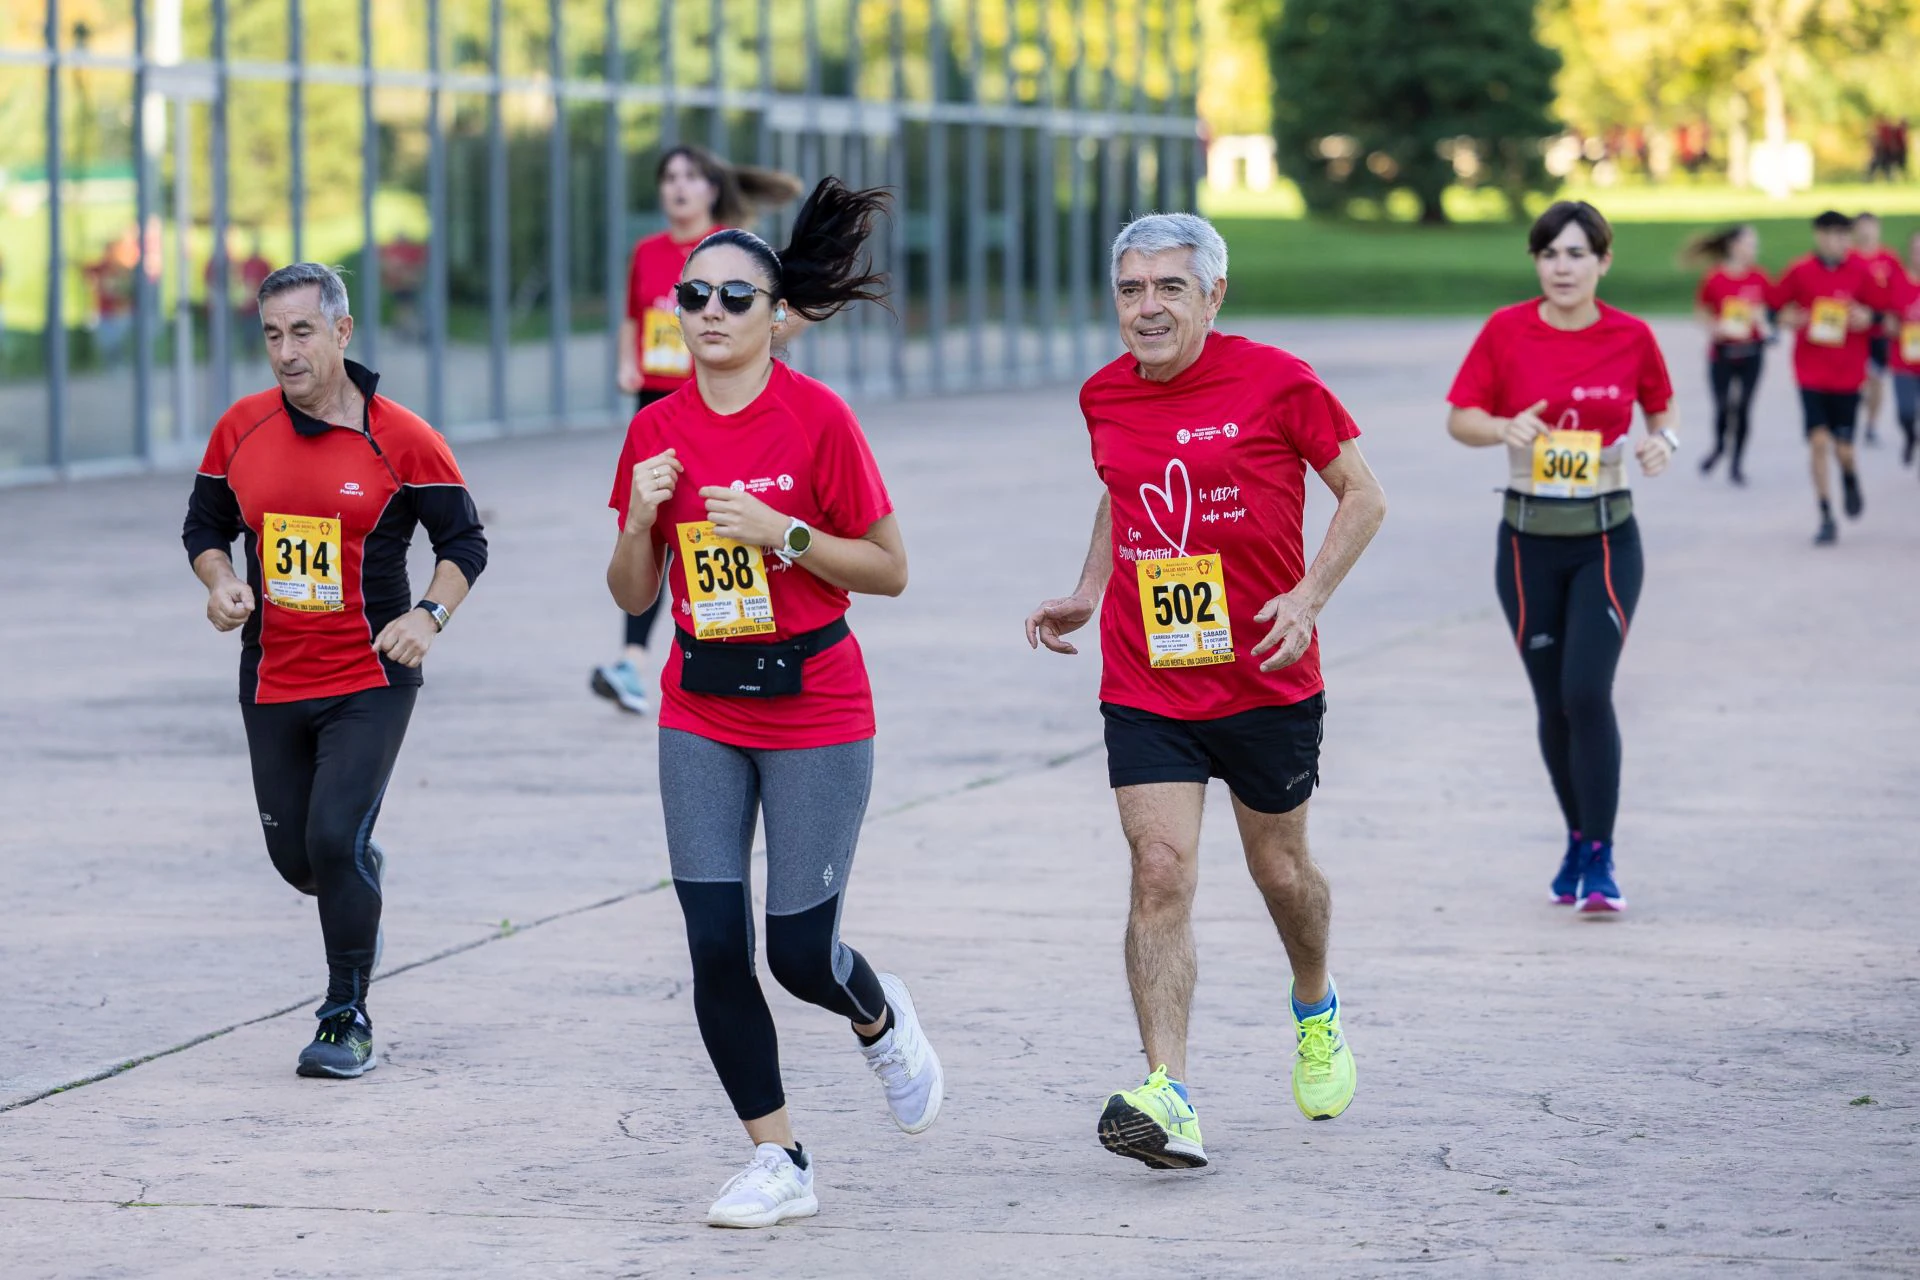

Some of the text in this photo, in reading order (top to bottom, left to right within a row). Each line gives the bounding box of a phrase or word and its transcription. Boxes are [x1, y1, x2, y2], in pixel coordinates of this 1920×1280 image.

[1543, 449, 1588, 479] 302
[1210, 486, 1240, 502] VIDA
[1202, 507, 1247, 524] sabe mejor
[276, 538, 330, 577] 314
[694, 545, 754, 593] 538
[1202, 629, 1227, 638] SÁBADO
[1159, 659, 1170, 667] SALUD
[1186, 657, 1195, 665] UNA
[1195, 656, 1213, 665] CARRERA
[1220, 653, 1233, 662] FONDO
